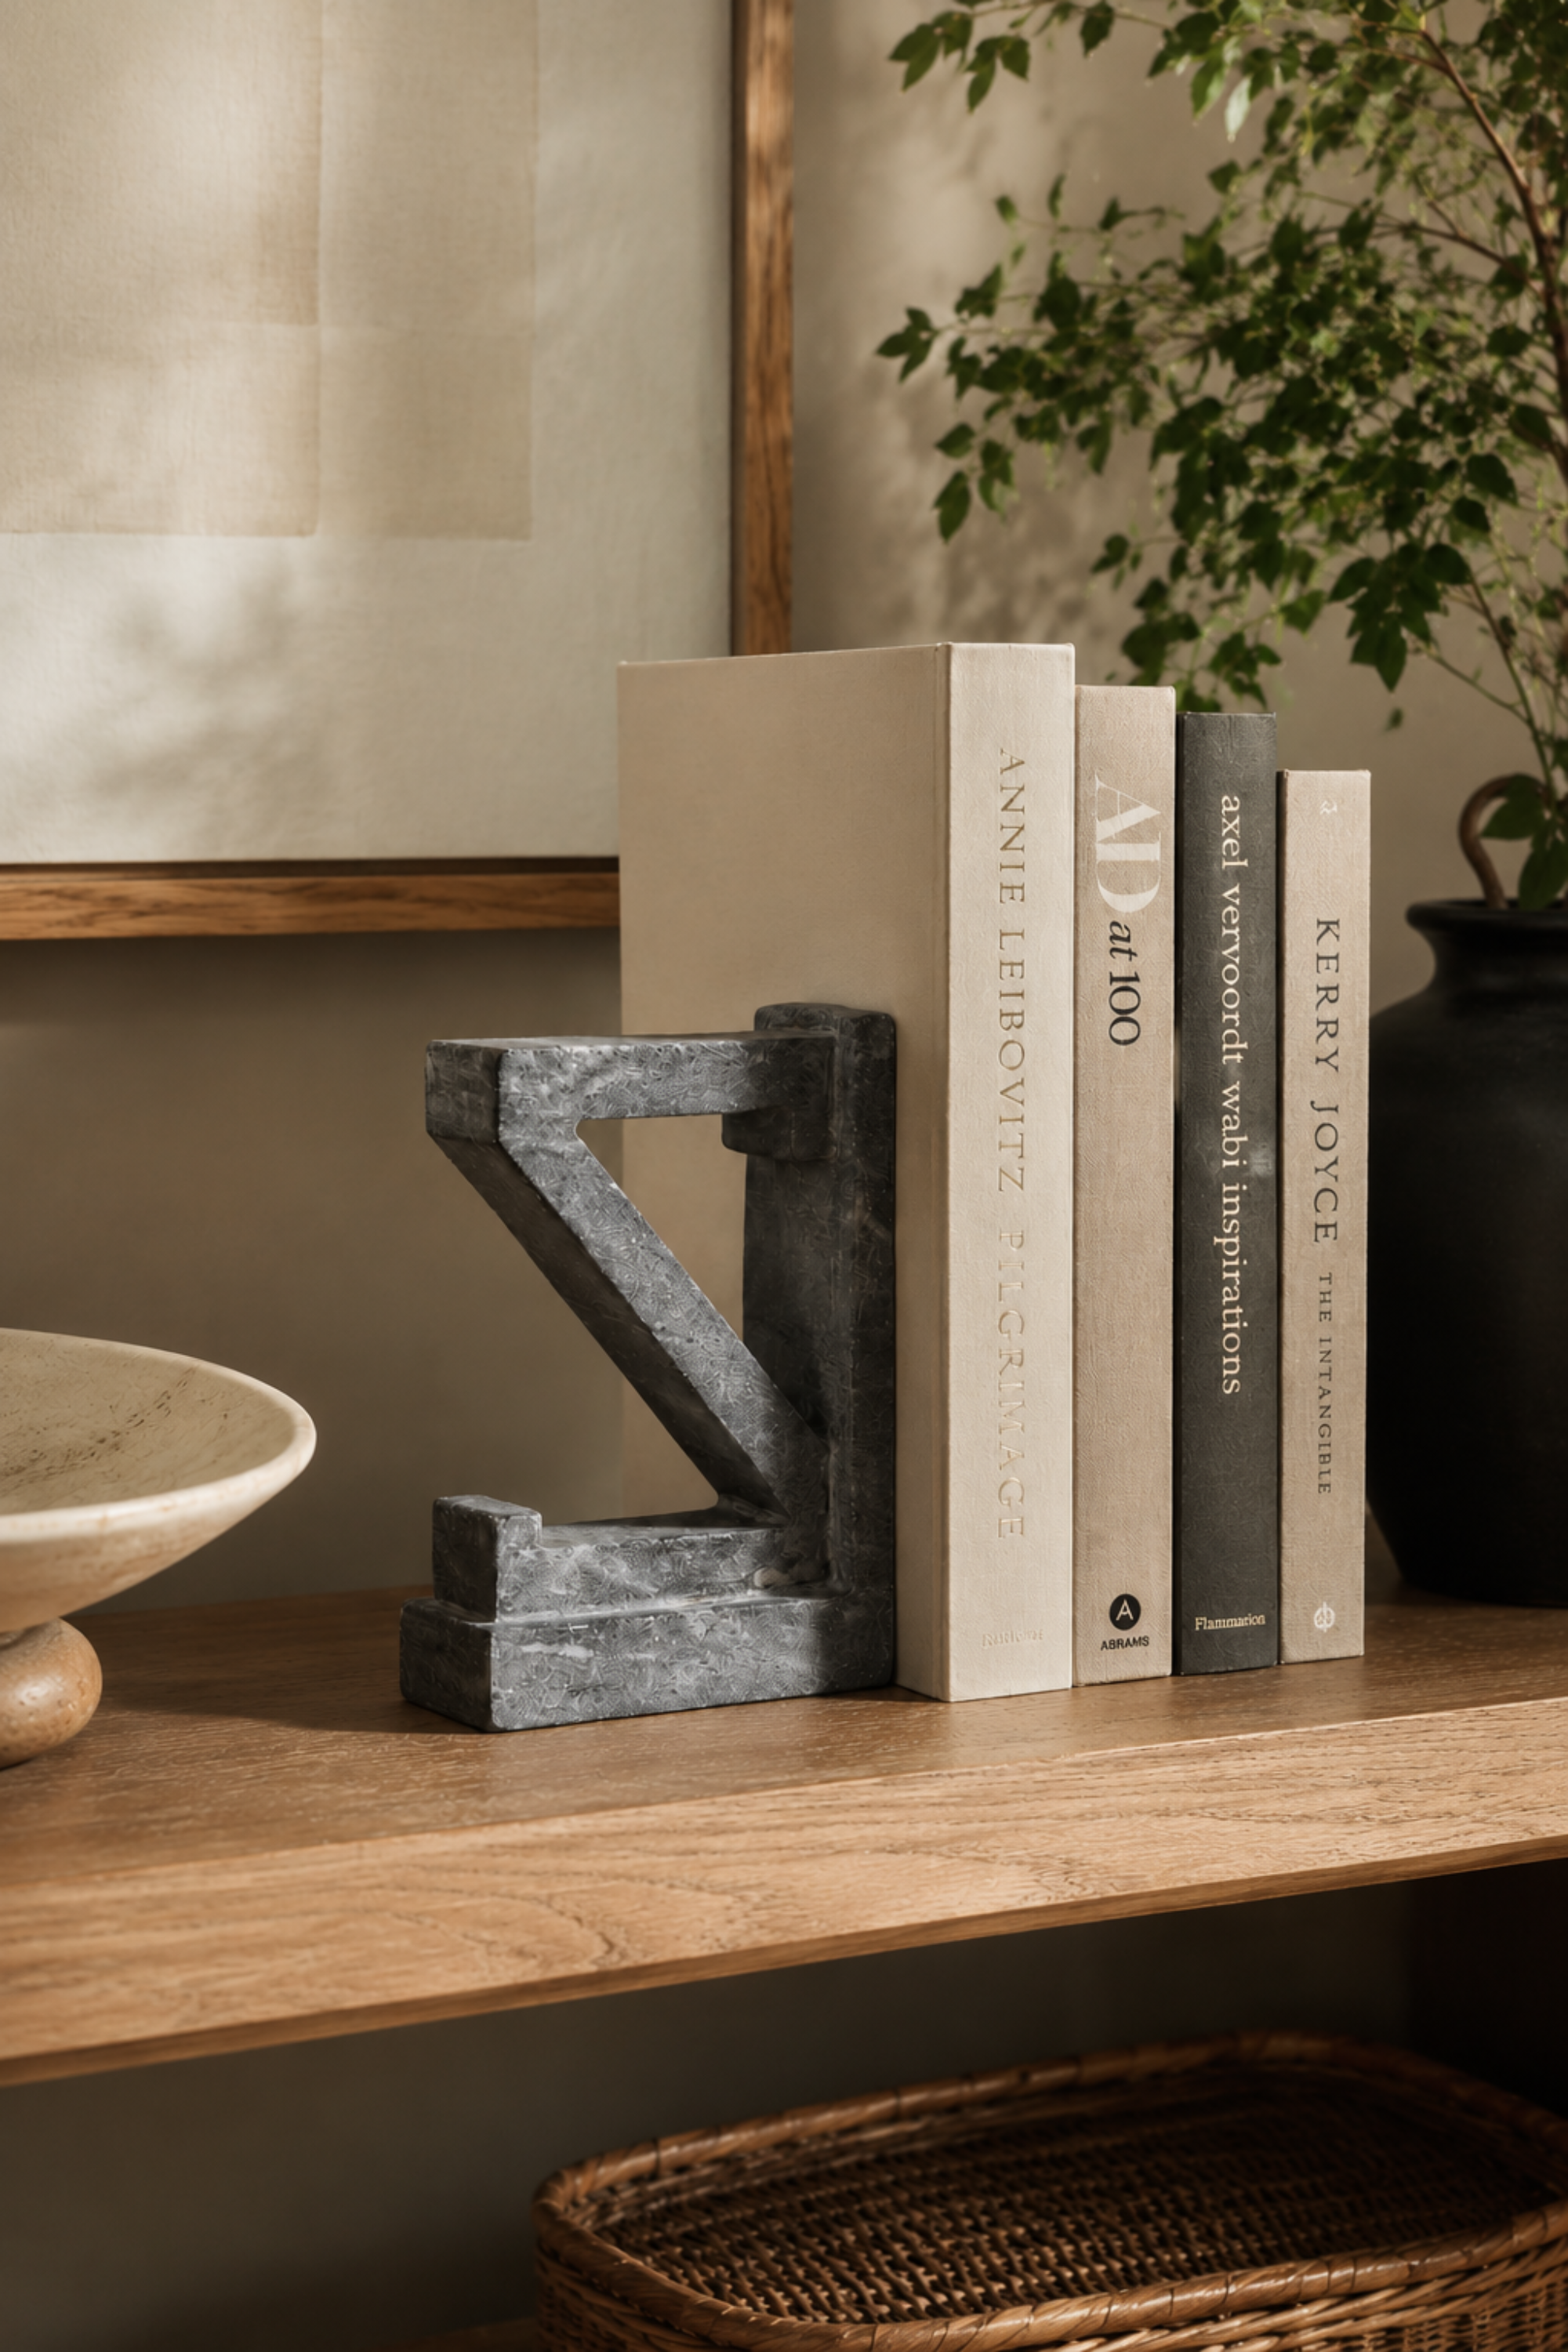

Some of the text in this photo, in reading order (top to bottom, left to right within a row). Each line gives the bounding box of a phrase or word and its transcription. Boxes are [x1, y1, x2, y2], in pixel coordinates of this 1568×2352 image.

[1094, 773, 1161, 1046] AD at 100
[997, 748, 1025, 1539] ANNIE LEIBOVITZ PILGRIMAGE
[1213, 794, 1249, 1396] axel vervoordt wabi inspirations
[1310, 918, 1341, 1243] KERRY JOYCE
[1317, 1271, 1333, 1495] THE INTANGIBLE
[1101, 1635, 1149, 1651] ABRAMS
[1195, 1613, 1265, 1631] Flammarion
